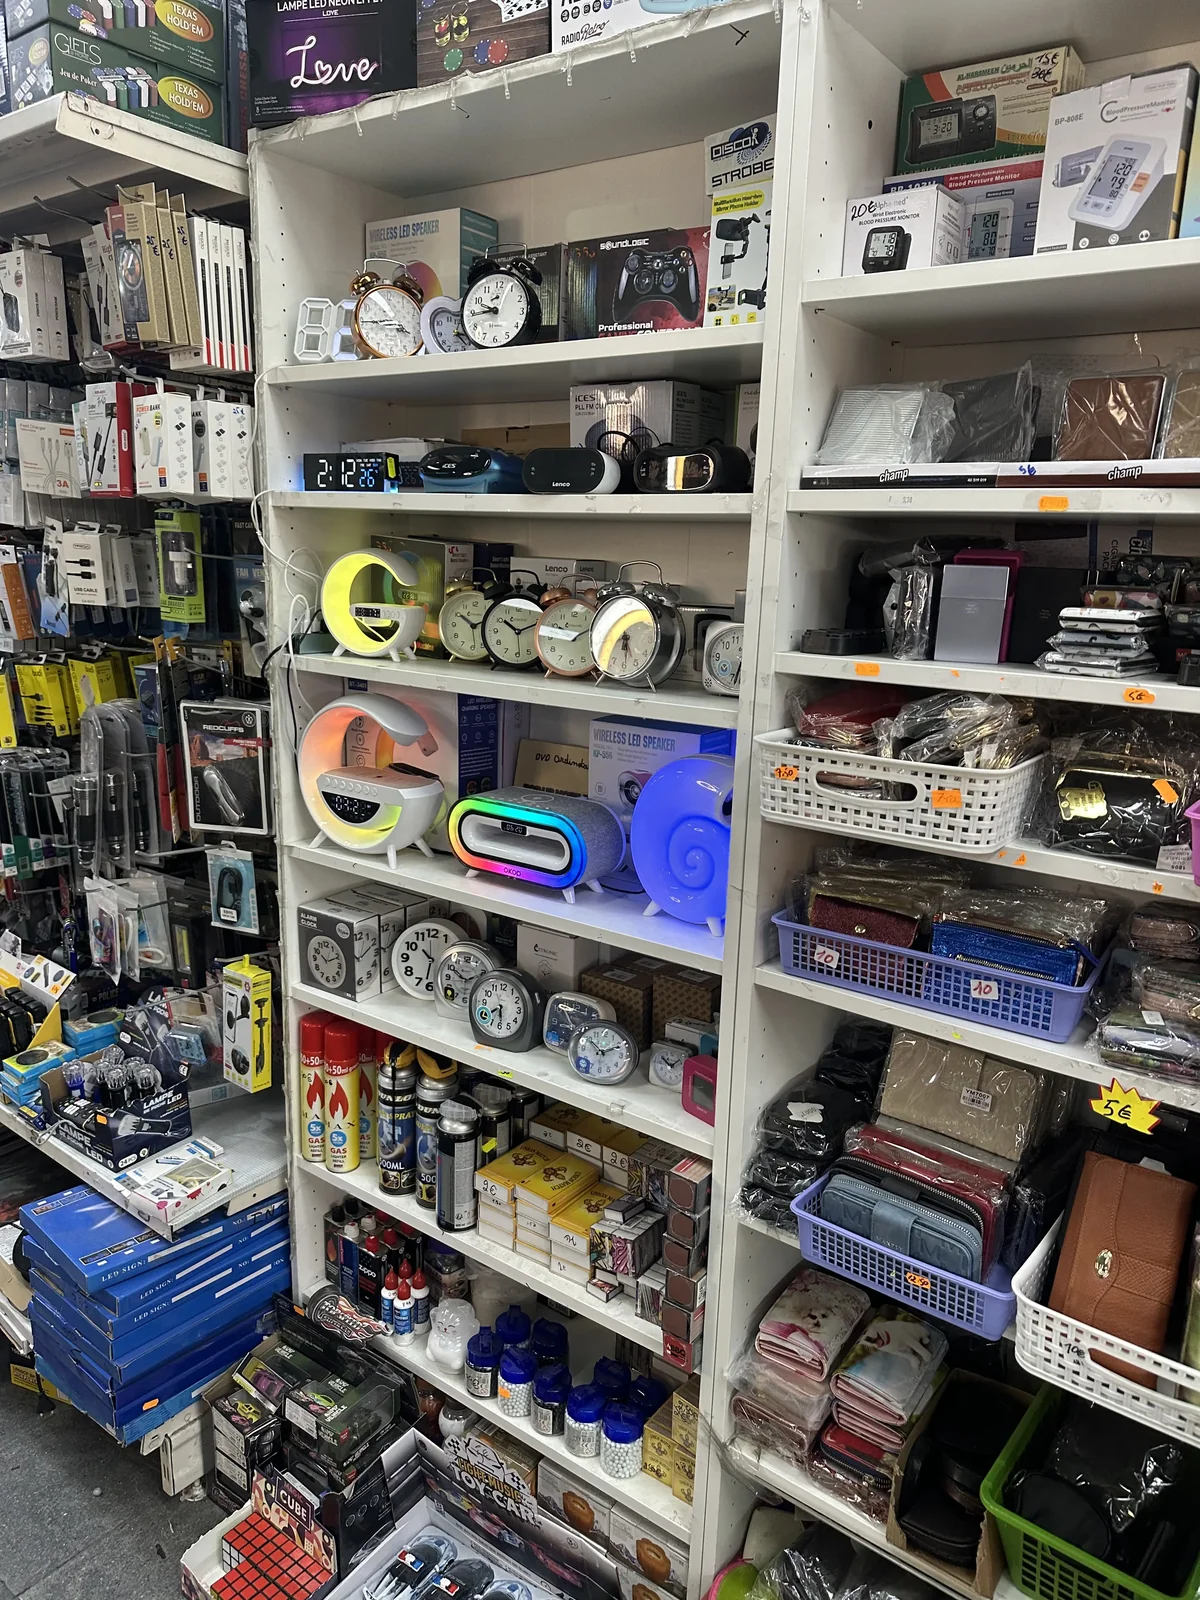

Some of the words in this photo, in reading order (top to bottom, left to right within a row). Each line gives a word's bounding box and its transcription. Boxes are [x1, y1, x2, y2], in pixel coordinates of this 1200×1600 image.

[172, 3, 199, 21] TEXAS
[277, 0, 307, 12] LAMPE
[309, 0, 327, 9] LED
[167, 15, 204, 38] HOLD'EM
[561, 30, 581, 45] RADIO
[54, 32, 102, 65] GIFTS
[286, 35, 379, 88] Love
[59, 67, 71, 78] Jeu
[72, 73, 80, 82] de
[80, 75, 98, 87] Poker
[239, 51, 249, 100] CHESS
[174, 81, 199, 99] TEXAS
[169, 92, 204, 114] HOLD'EM
[1054, 113, 1084, 126] BP-808E
[711, 137, 751, 160] DISCO
[712, 158, 775, 188] STROBE
[949, 179, 963, 188] Blood
[964, 177, 993, 187] Pressure
[994, 172, 1021, 183] Monitor
[850, 200, 876, 222] 20€
[884, 208, 907, 217] Electronic
[858, 219, 874, 227] BLOOD
[874, 216, 897, 225] PRESSURE
[897, 213, 920, 222] MONITOR
[983, 213, 998, 228] 120
[369, 225, 398, 243] WIRELESS
[399, 223, 411, 239] LED
[411, 219, 440, 237] SPEAKER
[984, 231, 997, 246] 80
[598, 321, 653, 332] Professional
[150, 404, 161, 412] BANK
[583, 403, 594, 411] FM
[317, 459, 356, 488] 2:12
[359, 468, 375, 487] 26
[879, 468, 910, 483] champ
[1108, 464, 1143, 482] champ
[57, 480, 69, 488] 3A
[236, 568, 248, 577] FAN
[544, 564, 568, 574] Lenco
[579, 565, 595, 573] Lenco
[203, 724, 245, 734] REDCLIFFS
[593, 727, 627, 745] WIRELESS
[628, 731, 641, 747] LED
[642, 735, 676, 752] SPEAKER
[301, 912, 317, 921] ALARM
[301, 919, 317, 928] CLOCK
[415, 931, 425, 941] 11
[426, 928, 439, 939] 12
[443, 934, 448, 943] 1
[405, 941, 418, 951] 10
[401, 952, 410, 962] 9
[404, 966, 413, 976] 8
[414, 977, 422, 986] 7
[425, 982, 433, 991] 6
[974, 982, 993, 996] 10
[143, 1089, 174, 1110] LAMPE
[167, 1093, 182, 1105] LED
[1103, 1099, 1132, 1120] 5€
[309, 1123, 321, 1132] 5x
[331, 1133, 344, 1143] 5x
[575, 1138, 592, 1153] 2€
[85, 1147, 103, 1163] LED
[330, 1147, 347, 1155] GAS
[610, 1151, 628, 1169] 2€
[482, 1179, 498, 1197] 2€
[101, 1269, 120, 1282] LED
[121, 1260, 147, 1274] SIGN:
[140, 1288, 154, 1300] LED
[154, 1278, 175, 1292] SIGN:
[133, 1312, 149, 1323] LED
[149, 1301, 170, 1314] SIGN:
[280, 1489, 307, 1522] CUBE
